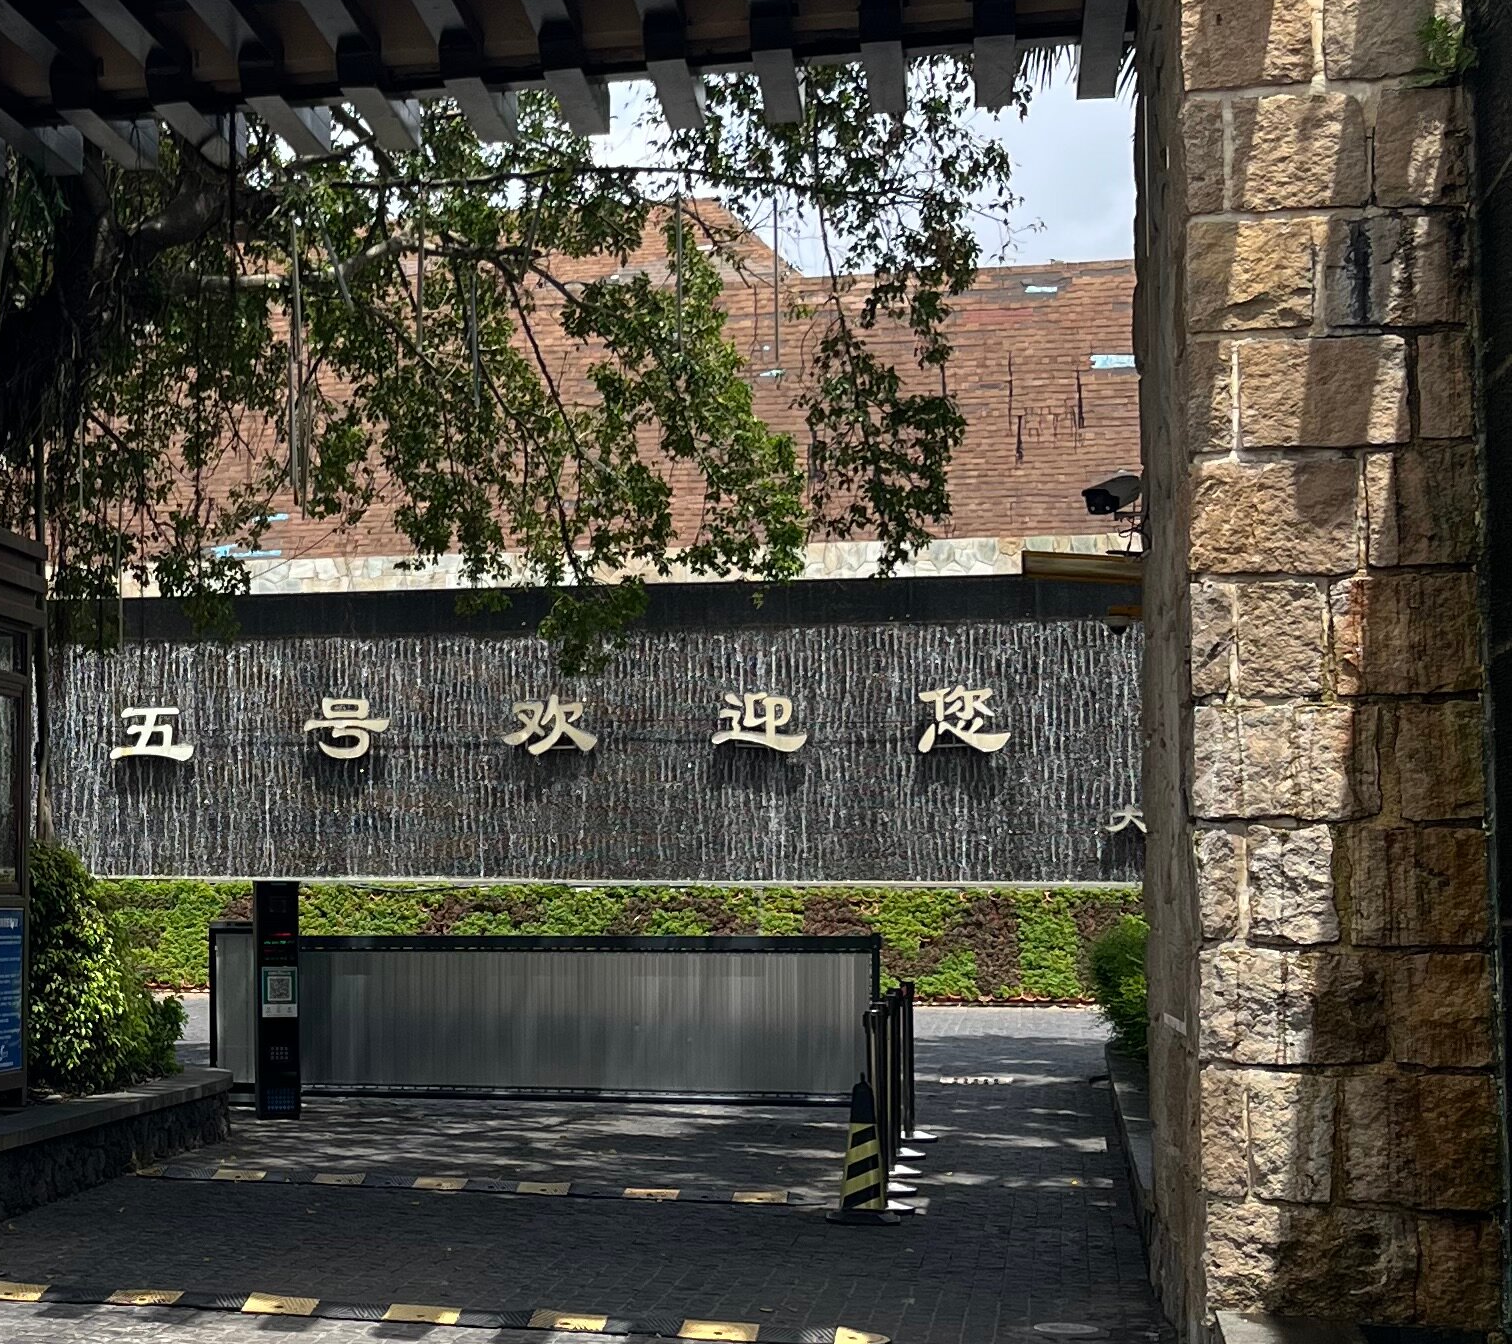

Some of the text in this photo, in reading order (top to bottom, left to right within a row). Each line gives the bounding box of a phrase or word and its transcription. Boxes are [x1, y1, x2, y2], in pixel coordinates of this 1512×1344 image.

[109, 686, 1012, 761] 五号欢迎您
